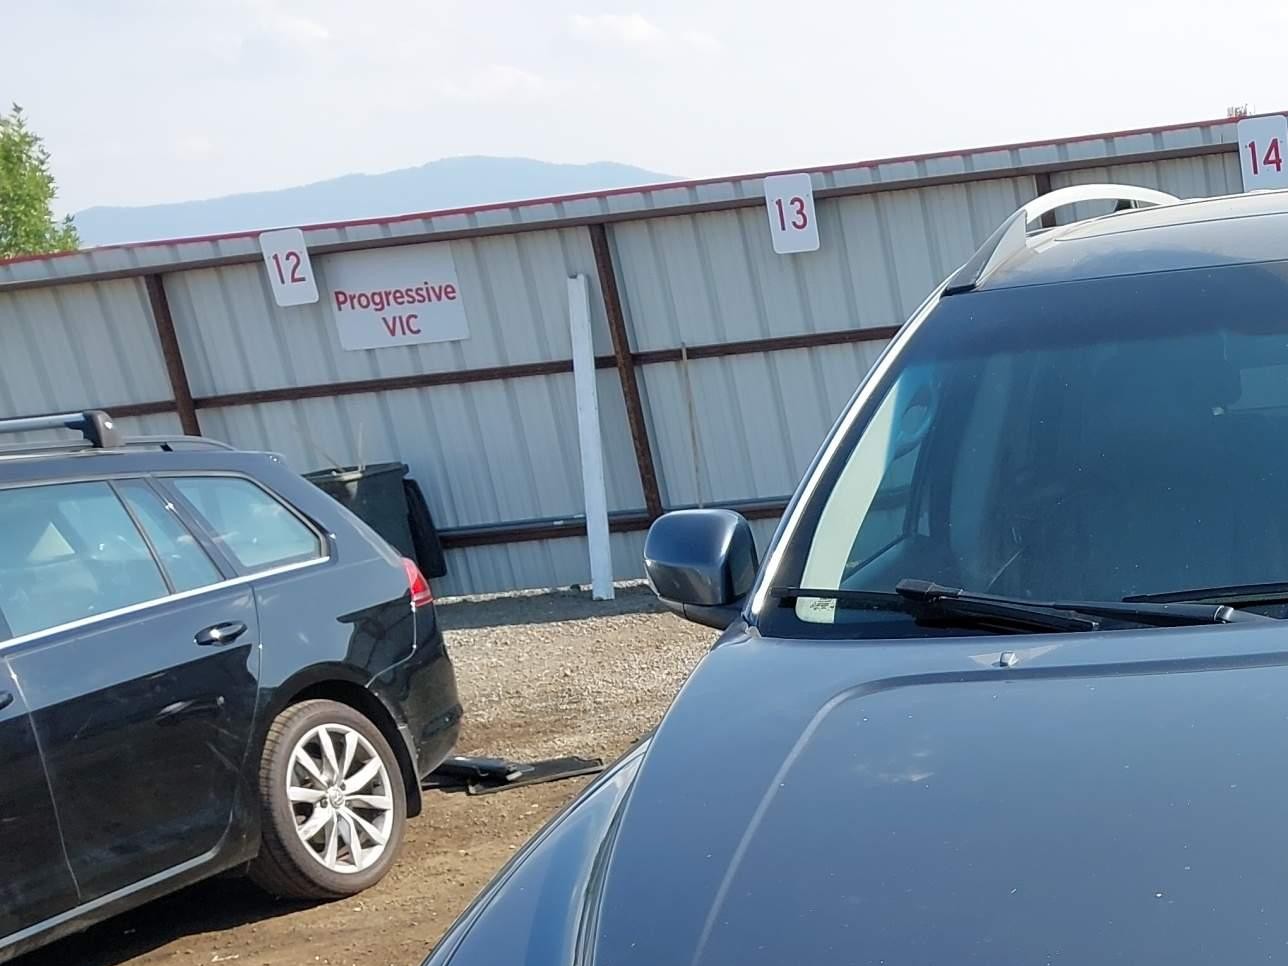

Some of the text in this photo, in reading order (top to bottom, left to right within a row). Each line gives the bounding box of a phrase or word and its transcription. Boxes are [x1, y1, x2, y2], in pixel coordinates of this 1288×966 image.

[1248, 138, 1283, 175] 14
[773, 196, 810, 232] 13
[271, 251, 307, 285] 12
[333, 280, 458, 315] Progressive
[381, 313, 422, 338] VIC
